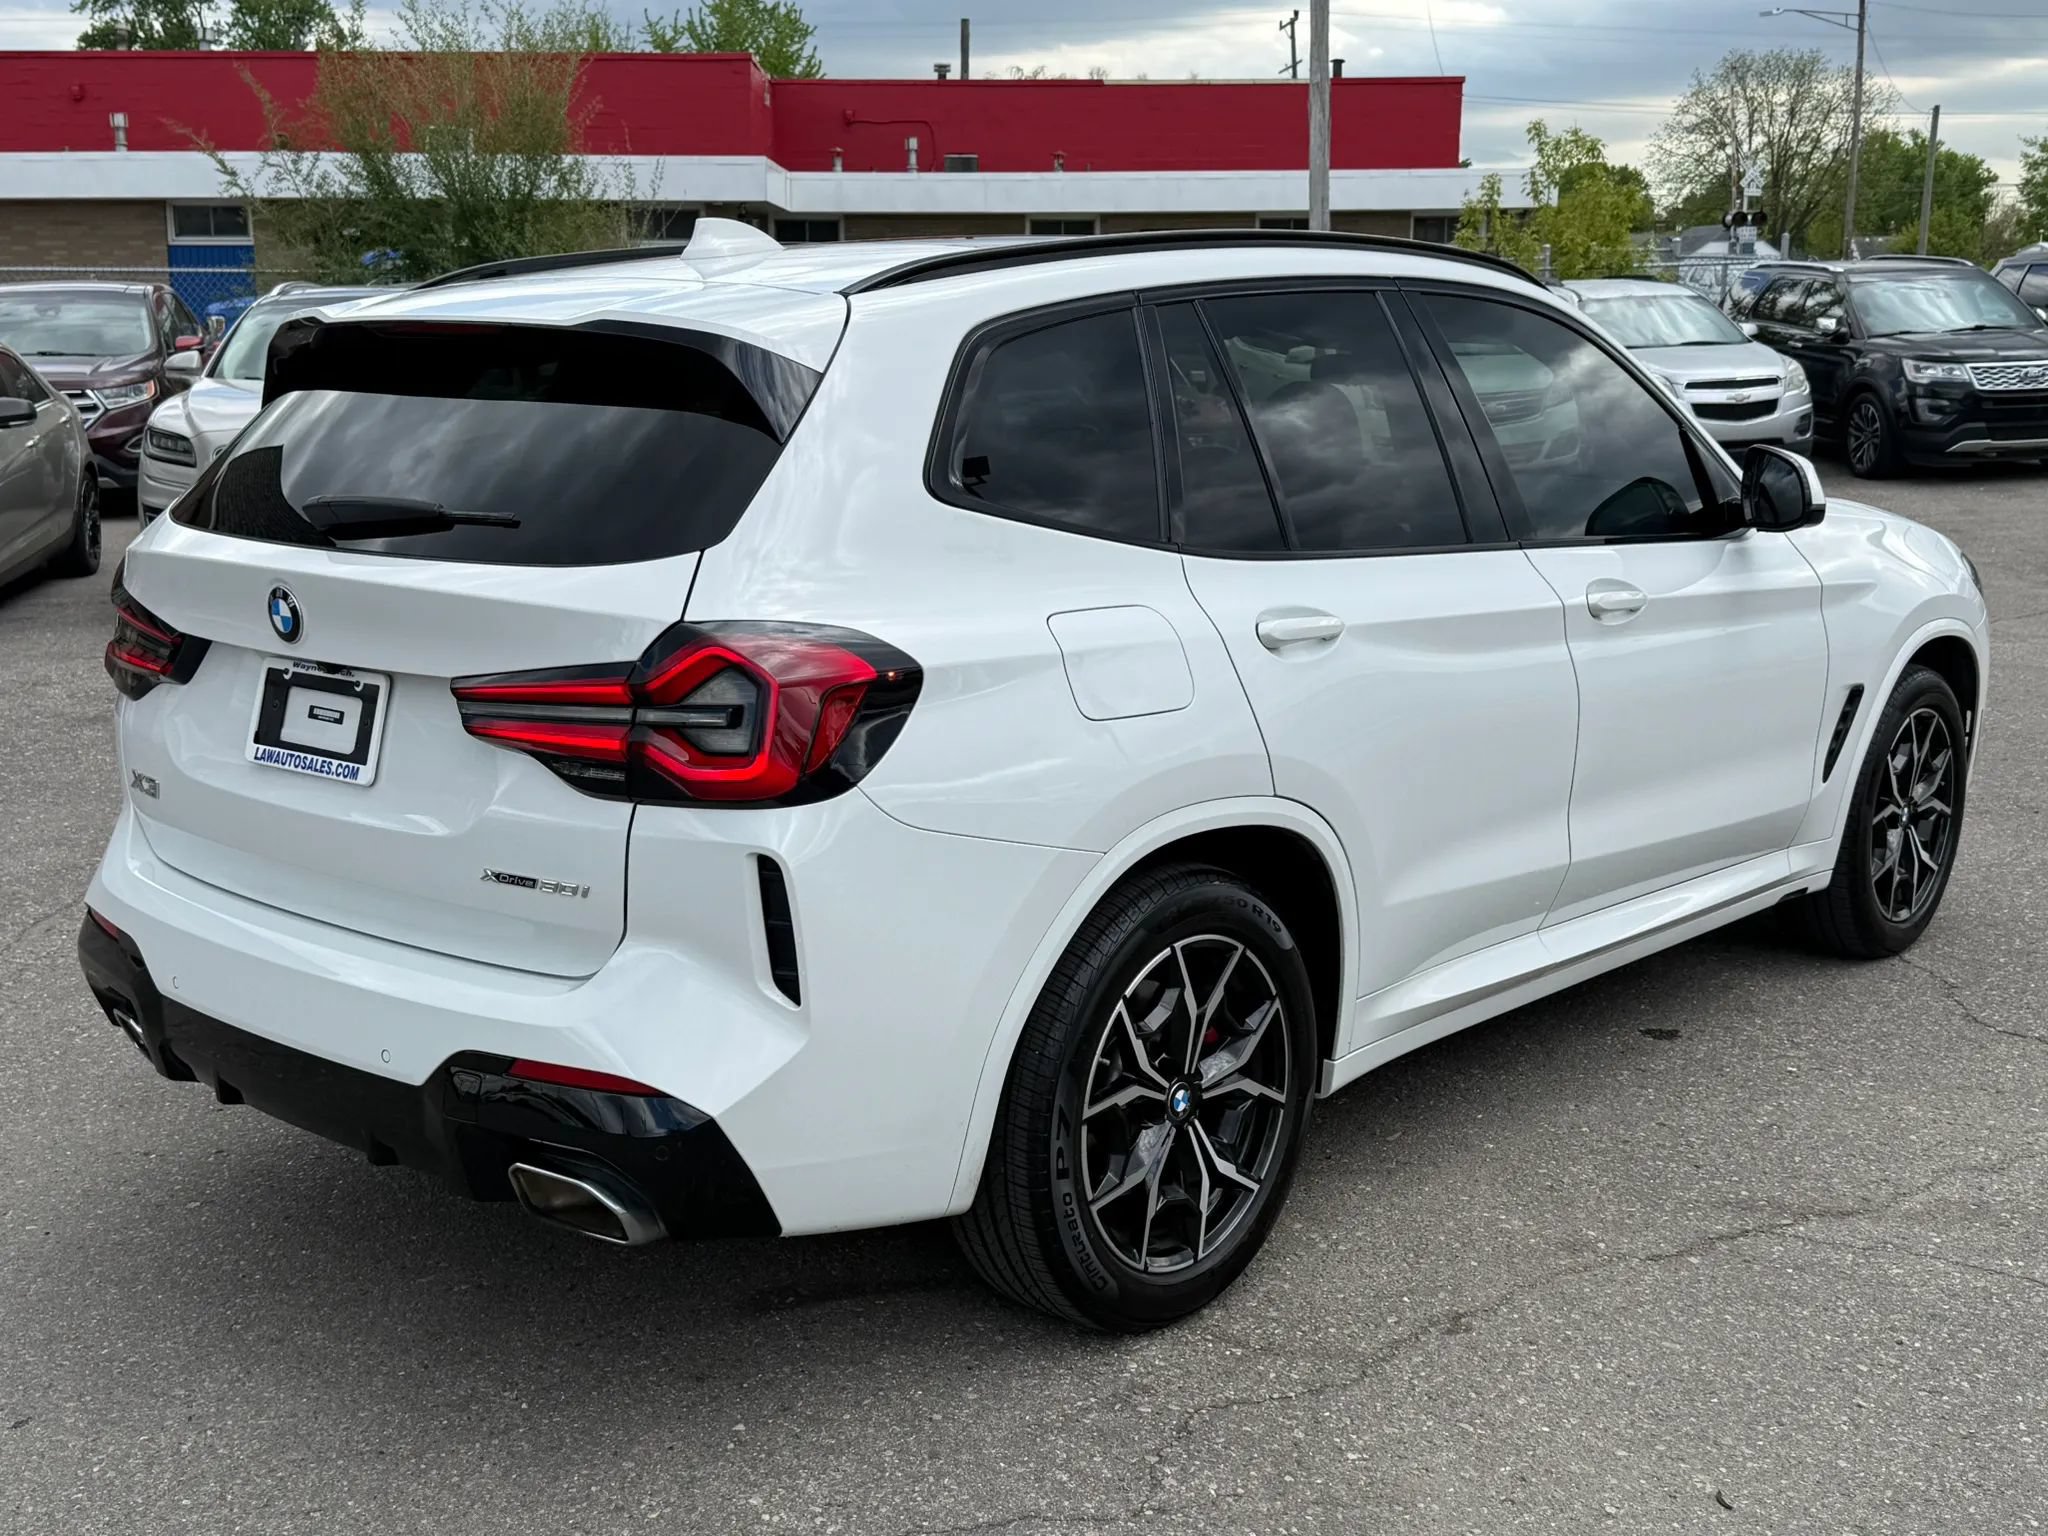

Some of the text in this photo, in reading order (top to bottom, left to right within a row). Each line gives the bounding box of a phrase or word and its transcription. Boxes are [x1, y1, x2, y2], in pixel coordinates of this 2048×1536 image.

[254, 747, 360, 780] LAWAUTOSALES.COM
[131, 769, 160, 800] X3
[540, 879, 590, 898] 30i
[1252, 904, 1282, 932] R19
[1056, 1104, 1070, 1180] P7
